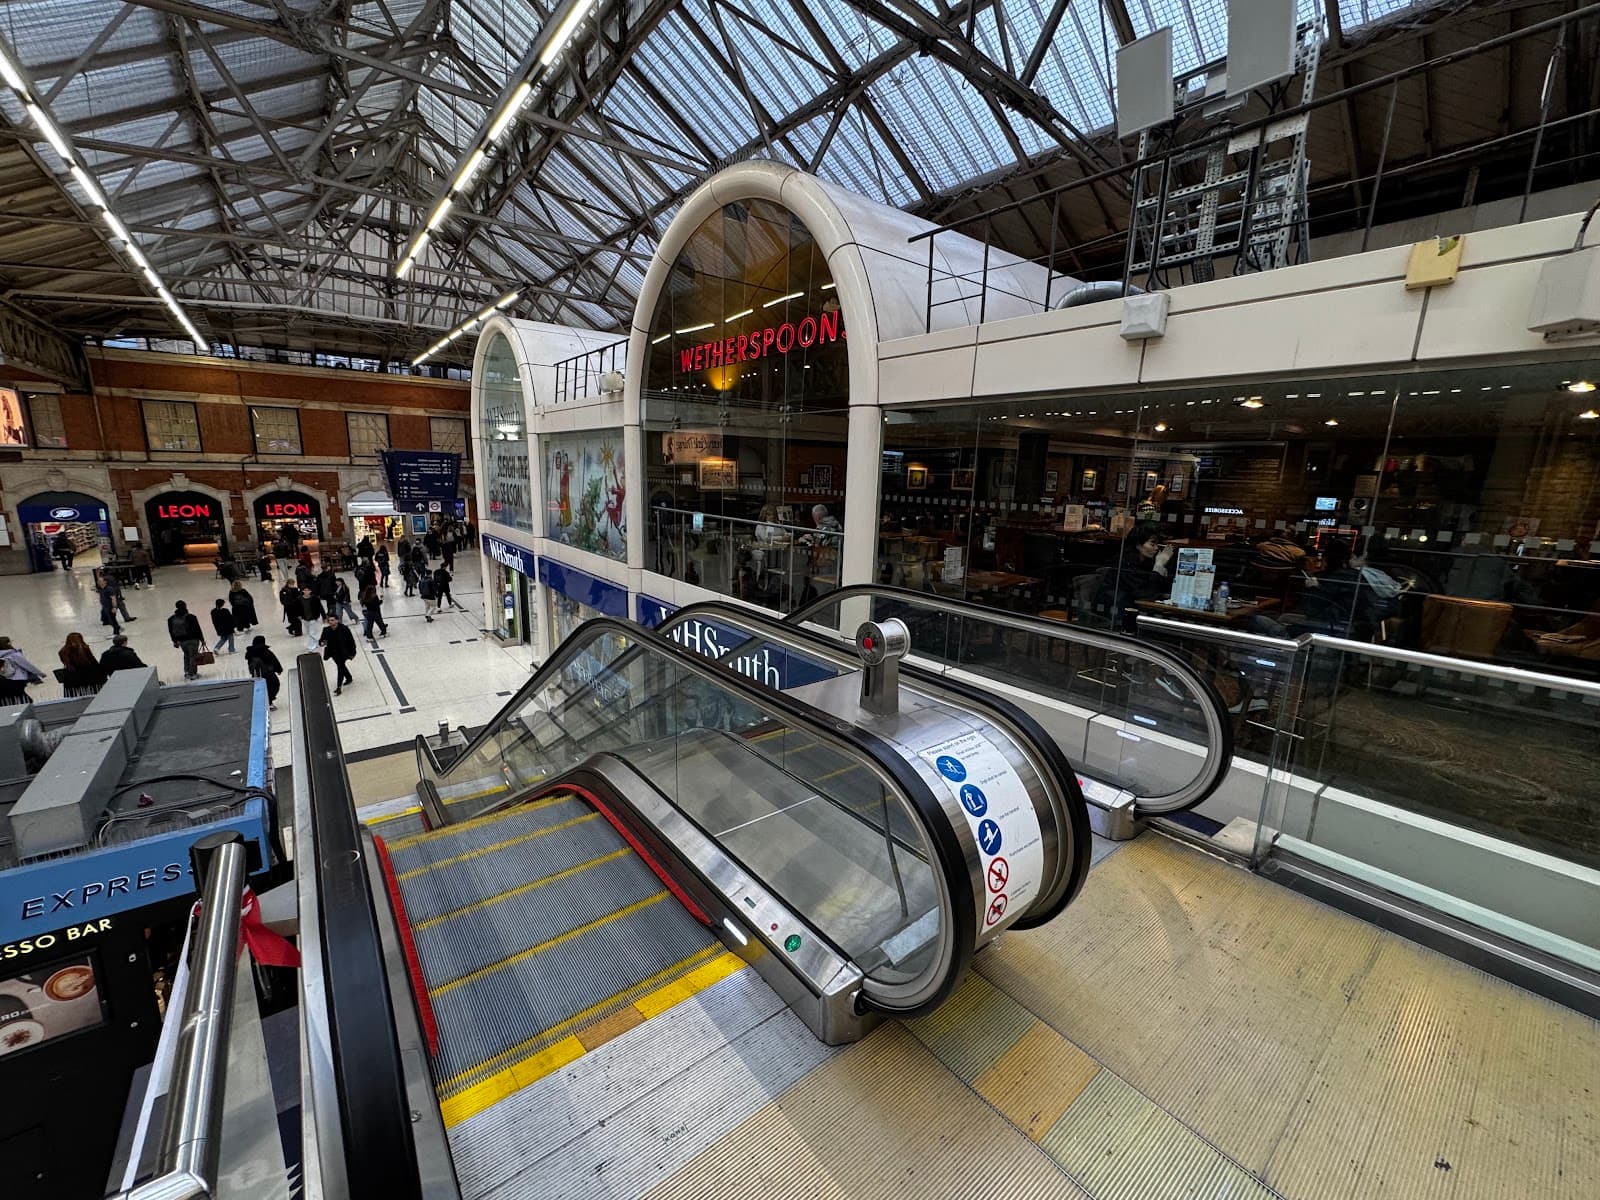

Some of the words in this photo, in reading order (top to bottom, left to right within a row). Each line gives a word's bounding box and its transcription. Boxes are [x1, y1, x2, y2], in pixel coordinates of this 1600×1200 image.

[159, 504, 210, 518] LEON
[265, 503, 310, 516] LEON
[489, 538, 525, 574] WHSmith
[22, 861, 194, 921] EXPRES
[0, 934, 56, 961] SSO
[66, 918, 113, 941] BAR
[0, 1010, 20, 1022] RO
